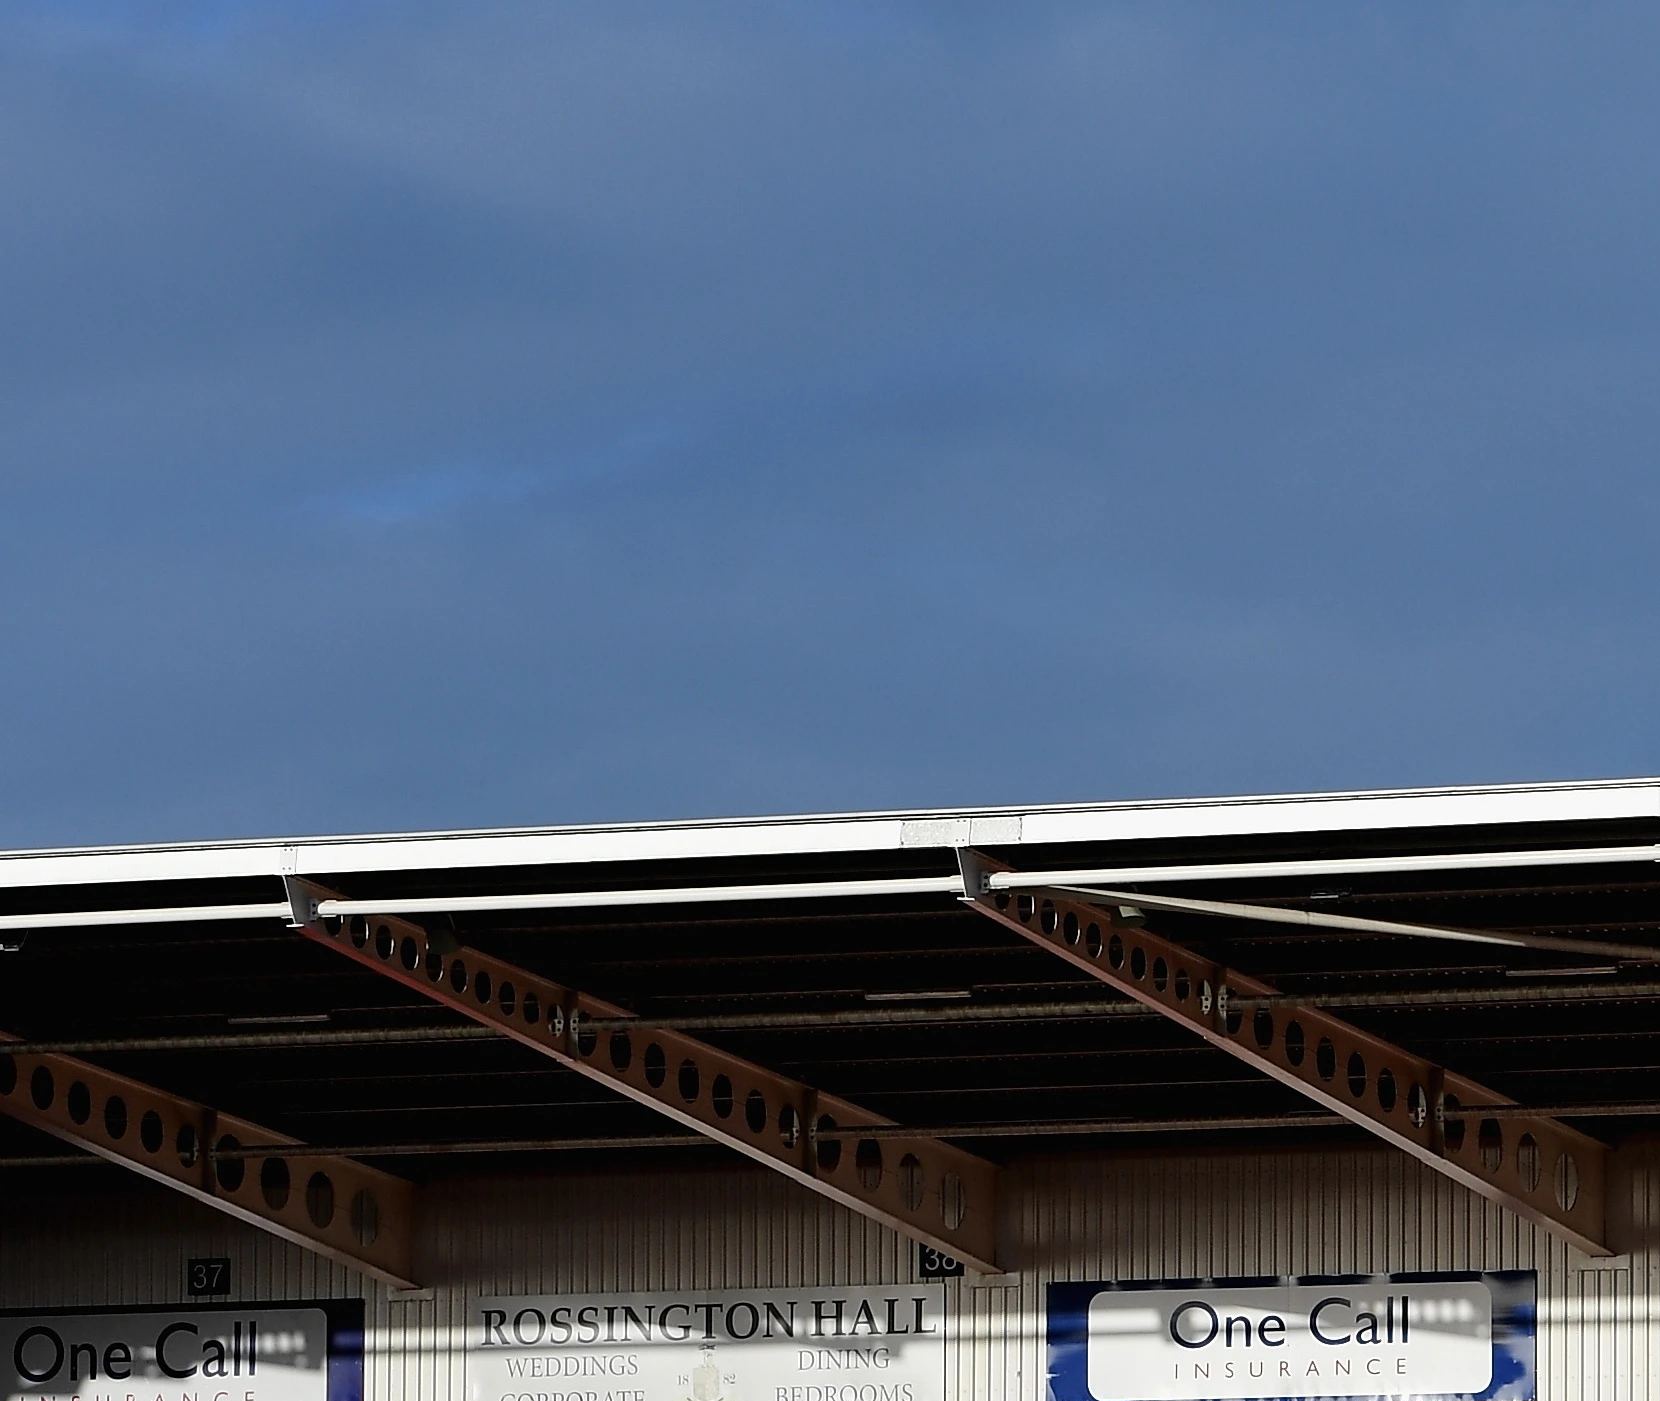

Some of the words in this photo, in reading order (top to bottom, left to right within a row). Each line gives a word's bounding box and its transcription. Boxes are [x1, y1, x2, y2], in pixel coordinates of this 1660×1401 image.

[193, 1265, 224, 1289] 37
[480, 1300, 797, 1347] ROSSINGTON
[810, 1296, 938, 1337] HALL
[1169, 1300, 1287, 1349] One
[1308, 1296, 1410, 1346] Call
[13, 1326, 133, 1382] One
[155, 1321, 257, 1379] Call
[797, 1347, 891, 1371] DINING
[505, 1354, 640, 1378] WEDDINGS
[1173, 1358, 1411, 1379] INSURANCE
